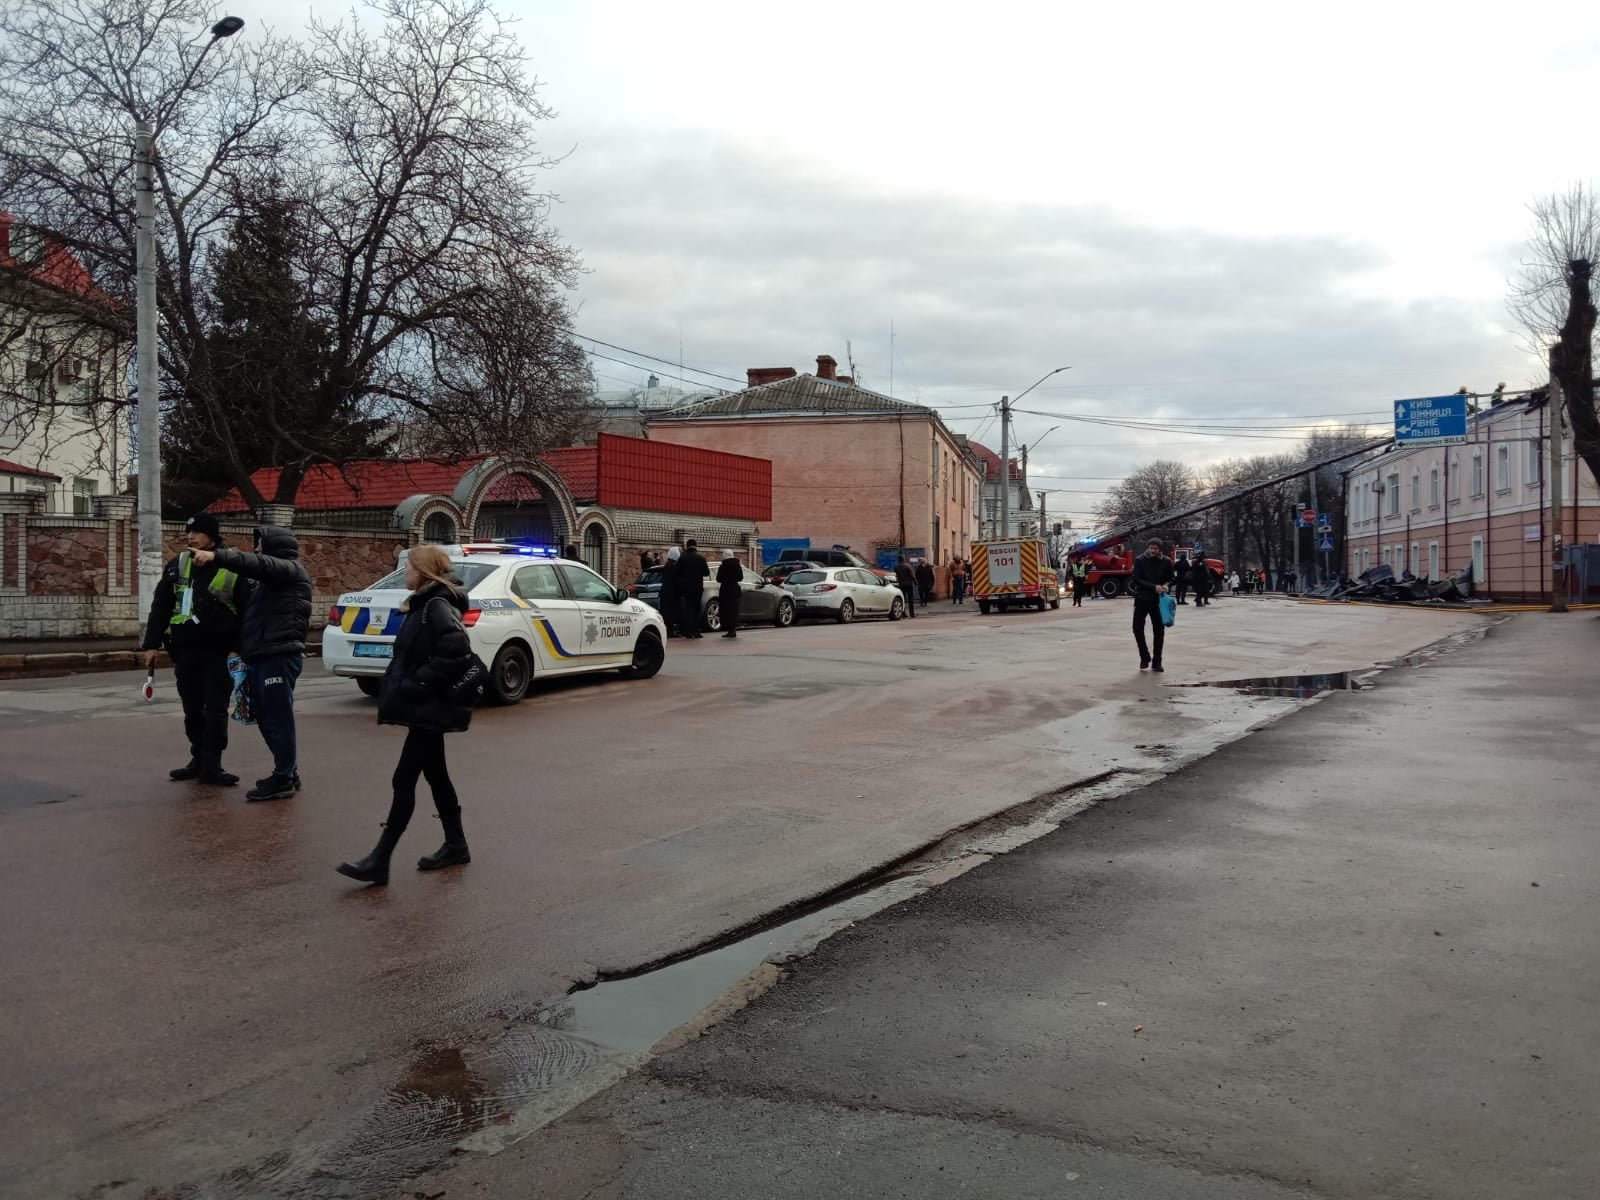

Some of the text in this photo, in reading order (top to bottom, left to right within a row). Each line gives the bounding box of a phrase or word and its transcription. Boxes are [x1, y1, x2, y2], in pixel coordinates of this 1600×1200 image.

[1410, 400, 1432, 408] КИЇВ
[1410, 408, 1451, 418] ВІННИЦЯ
[1410, 418, 1438, 427] РІВНЕ
[1412, 428, 1440, 436] ЛЬВІВ
[994, 558, 1014, 566] 101
[342, 596, 373, 604] ПОЛІЦІЯ
[490, 599, 504, 607] 102
[599, 616, 632, 625] ПАТРУЛЬНА
[601, 626, 630, 638] ПОЛІЦІЯ
[264, 677, 284, 686] NIKE
